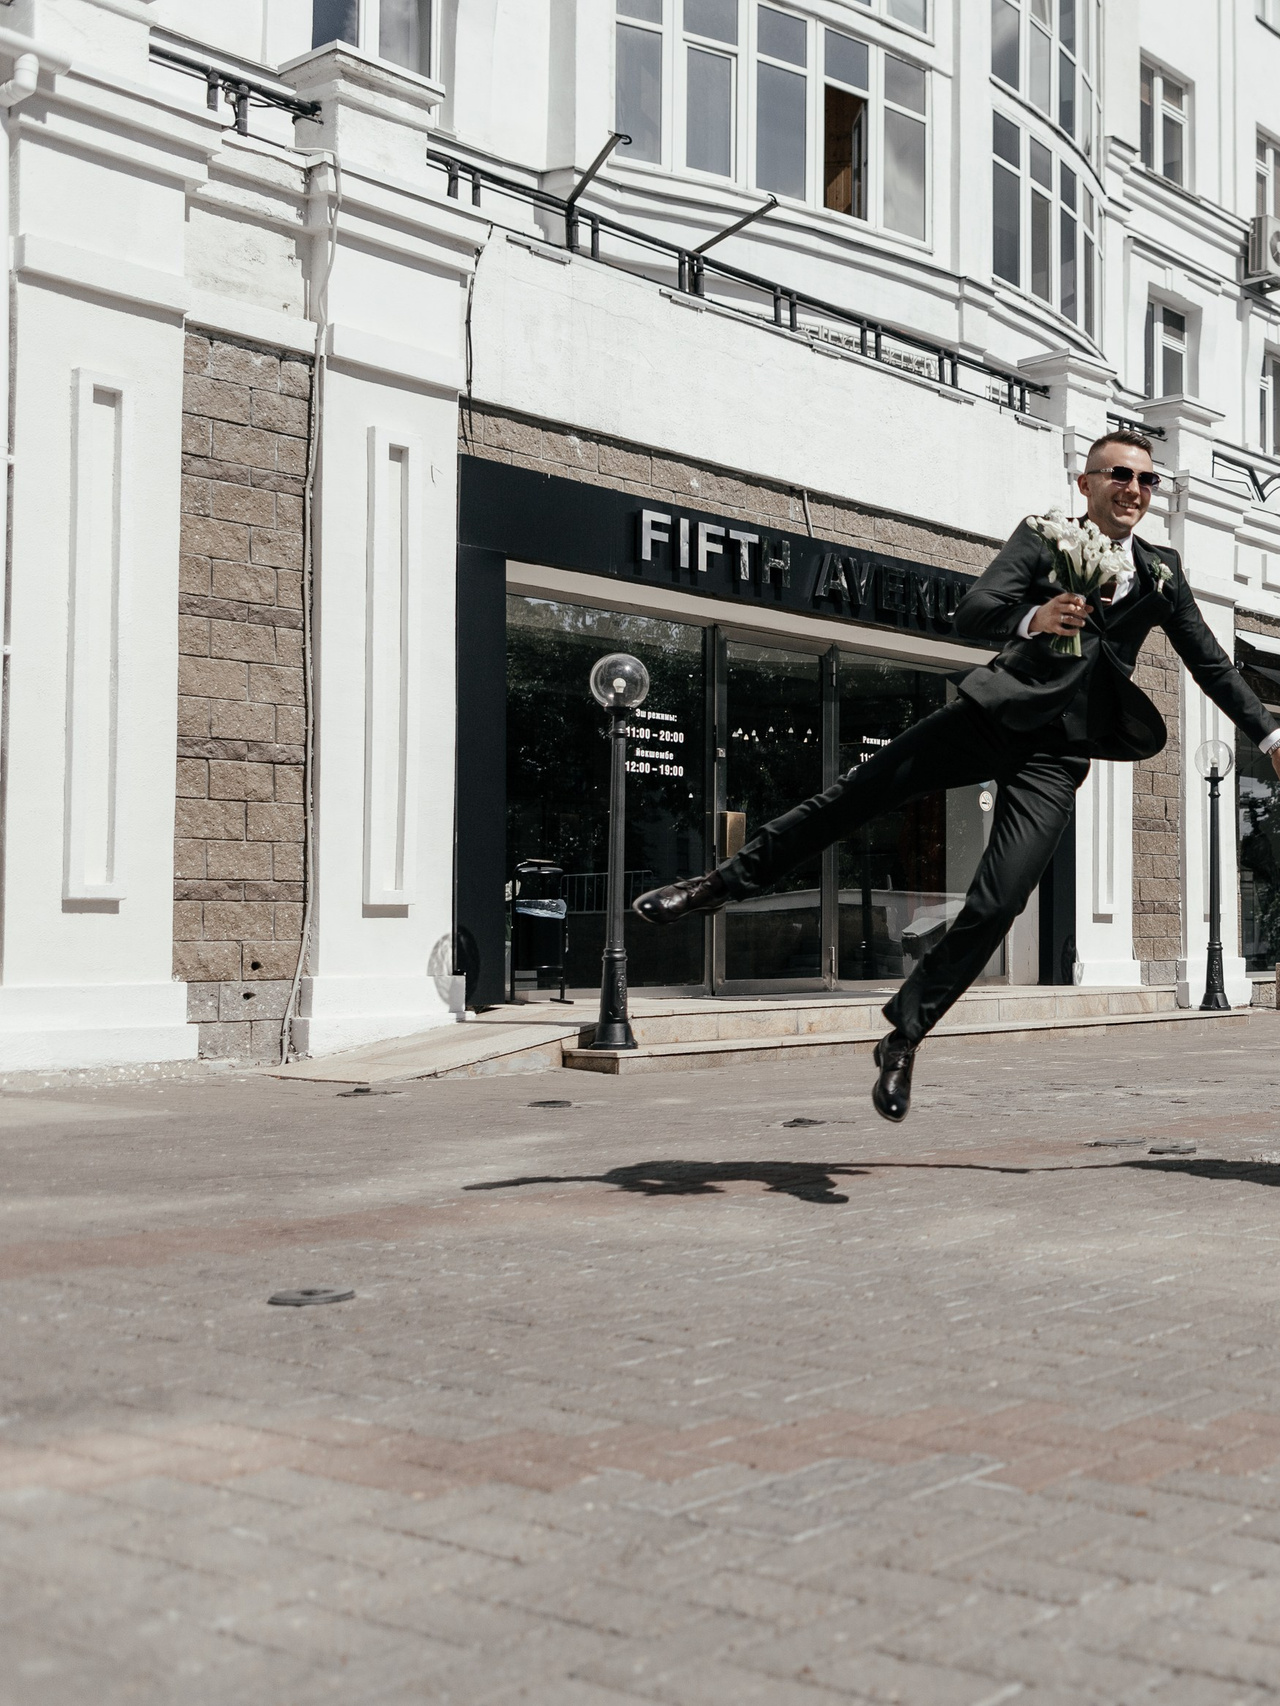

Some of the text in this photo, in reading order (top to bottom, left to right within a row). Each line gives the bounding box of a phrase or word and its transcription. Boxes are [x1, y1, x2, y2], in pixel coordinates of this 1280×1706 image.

[641, 509, 974, 624] FIFTH AVENU
[625, 726, 651, 740] 11:00
[659, 730, 684, 744] 20:00
[625, 761, 651, 774] 12:00
[659, 764, 684, 777] 19:00
